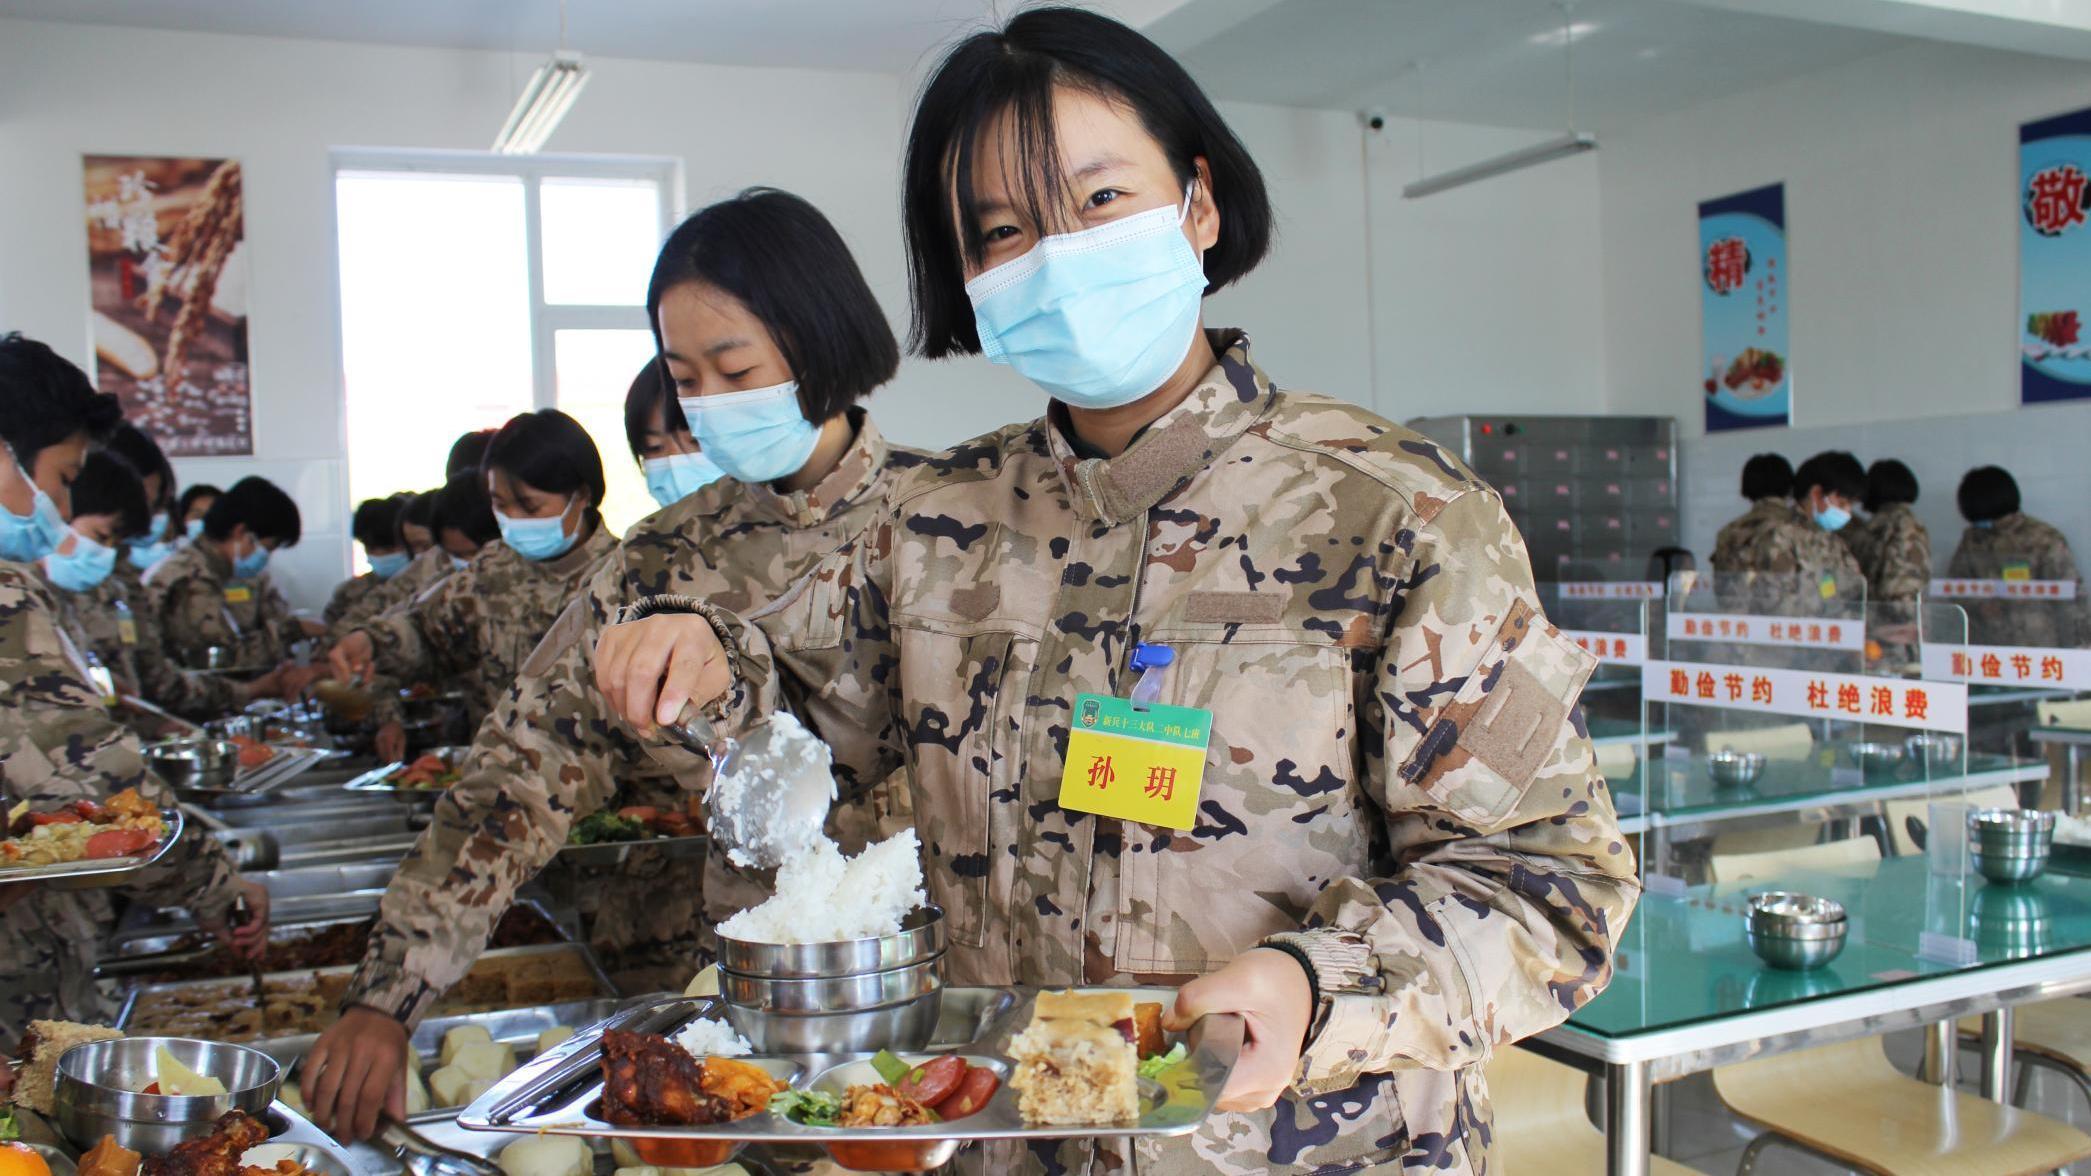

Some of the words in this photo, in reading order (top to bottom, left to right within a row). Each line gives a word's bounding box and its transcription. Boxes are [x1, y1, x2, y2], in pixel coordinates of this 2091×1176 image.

[2032, 166, 2086, 231] 敬
[1951, 650, 2064, 682] 勤俭节约
[1669, 668, 1773, 705] 勤俭节约
[1807, 680, 1929, 720] 杜绝浪费
[1087, 755, 1116, 790] 孙
[1143, 765, 1178, 802] 玥
